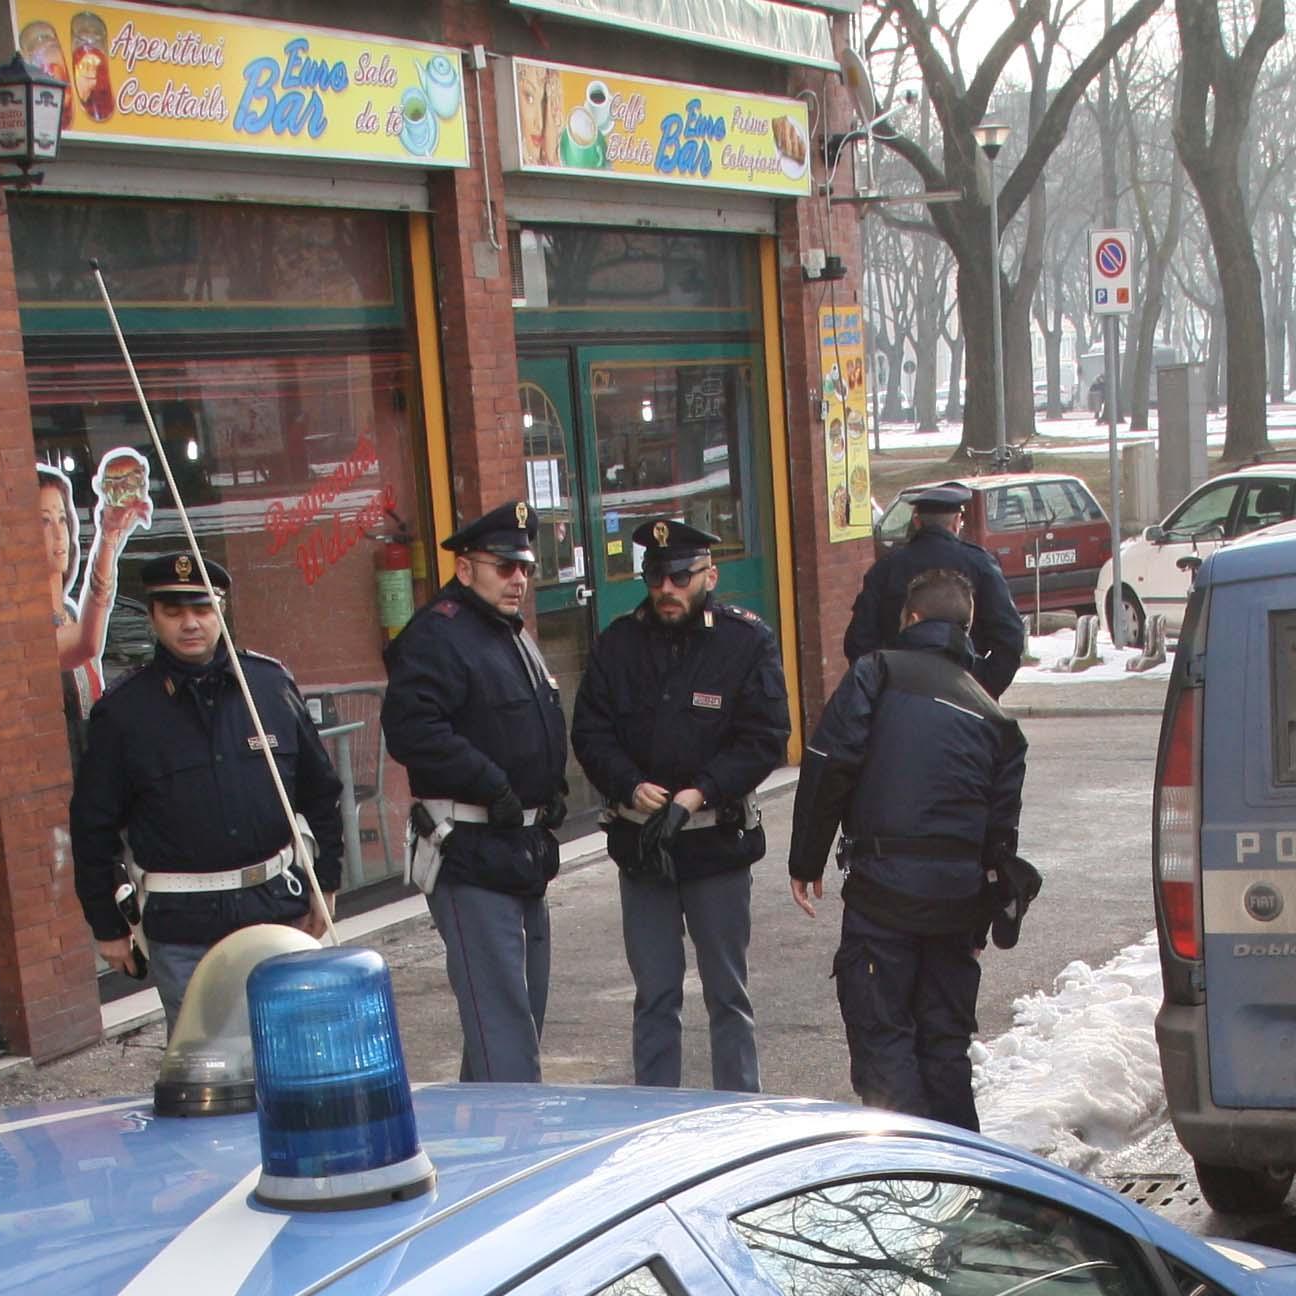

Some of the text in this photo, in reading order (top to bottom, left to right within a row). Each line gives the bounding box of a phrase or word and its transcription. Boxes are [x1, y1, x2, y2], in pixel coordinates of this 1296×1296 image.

[109, 21, 224, 73] Aperitivi
[281, 38, 349, 93] Euro
[354, 52, 398, 87] Sala
[117, 77, 229, 123] Cocktails
[233, 57, 328, 139] Bar
[355, 101, 379, 134] da
[655, 113, 712, 178] Bar
[1249, 895, 1276, 909] FIAT
